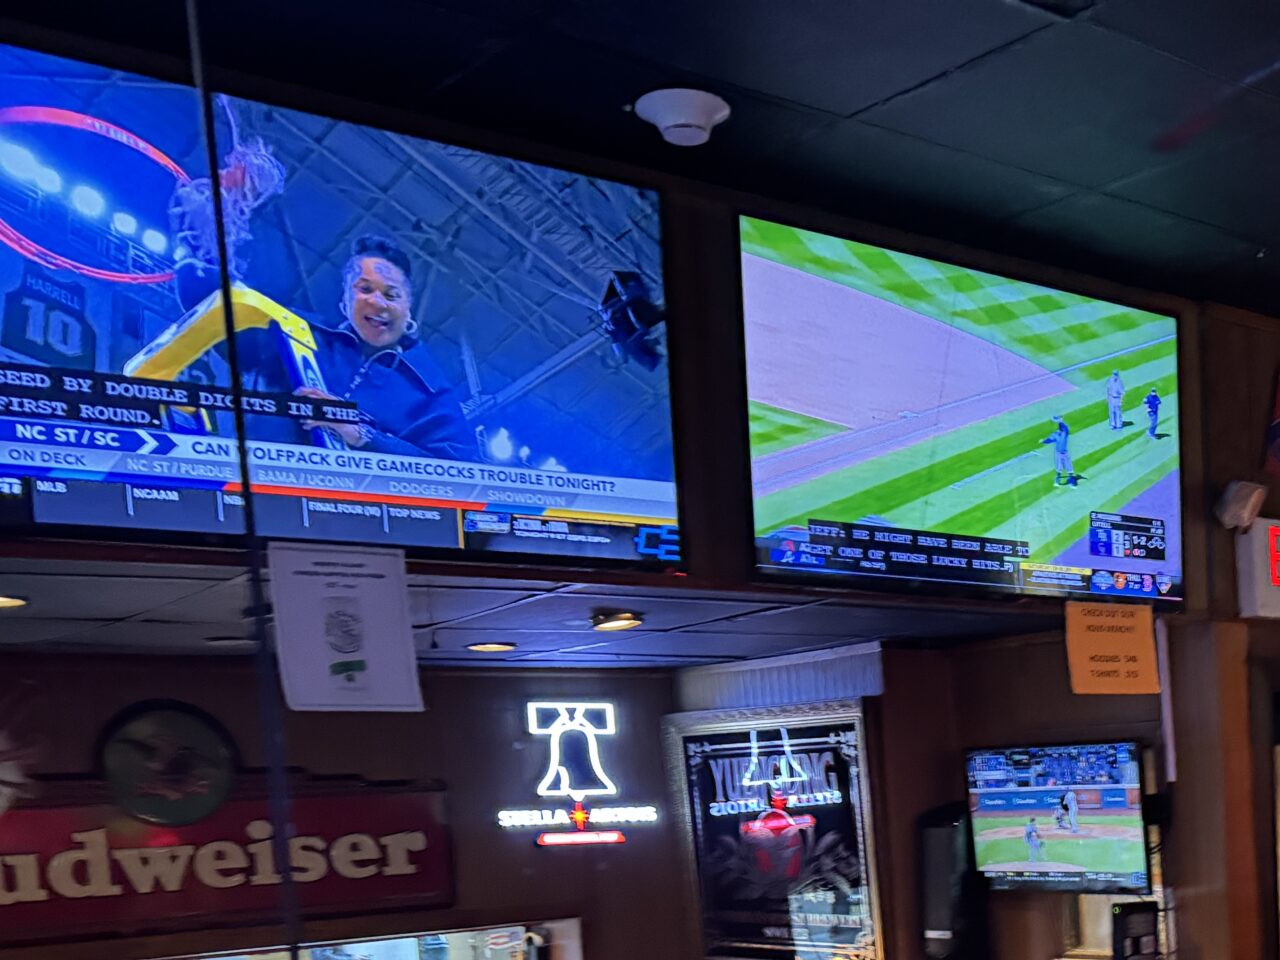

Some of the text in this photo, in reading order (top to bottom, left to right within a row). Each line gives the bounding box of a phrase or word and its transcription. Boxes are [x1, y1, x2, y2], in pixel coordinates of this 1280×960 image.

[21, 296, 83, 357] 10
[63, 376, 93, 393] BY
[105, 381, 189, 403] DOUBLE
[288, 401, 313, 416] IN
[323, 405, 360, 422] THE
[80, 404, 162, 426] ROUND.
[16, 423, 47, 441] NC
[8, 448, 87, 467] ON DECK
[192, 440, 617, 494] CAN OLFPACK GIVE GAMECOCKS TROUBLE TONIGHT?
[389, 481, 455, 498] DODGERS
[487, 490, 567, 507] SHOWDOWN
[0, 818, 429, 905] udweiser
